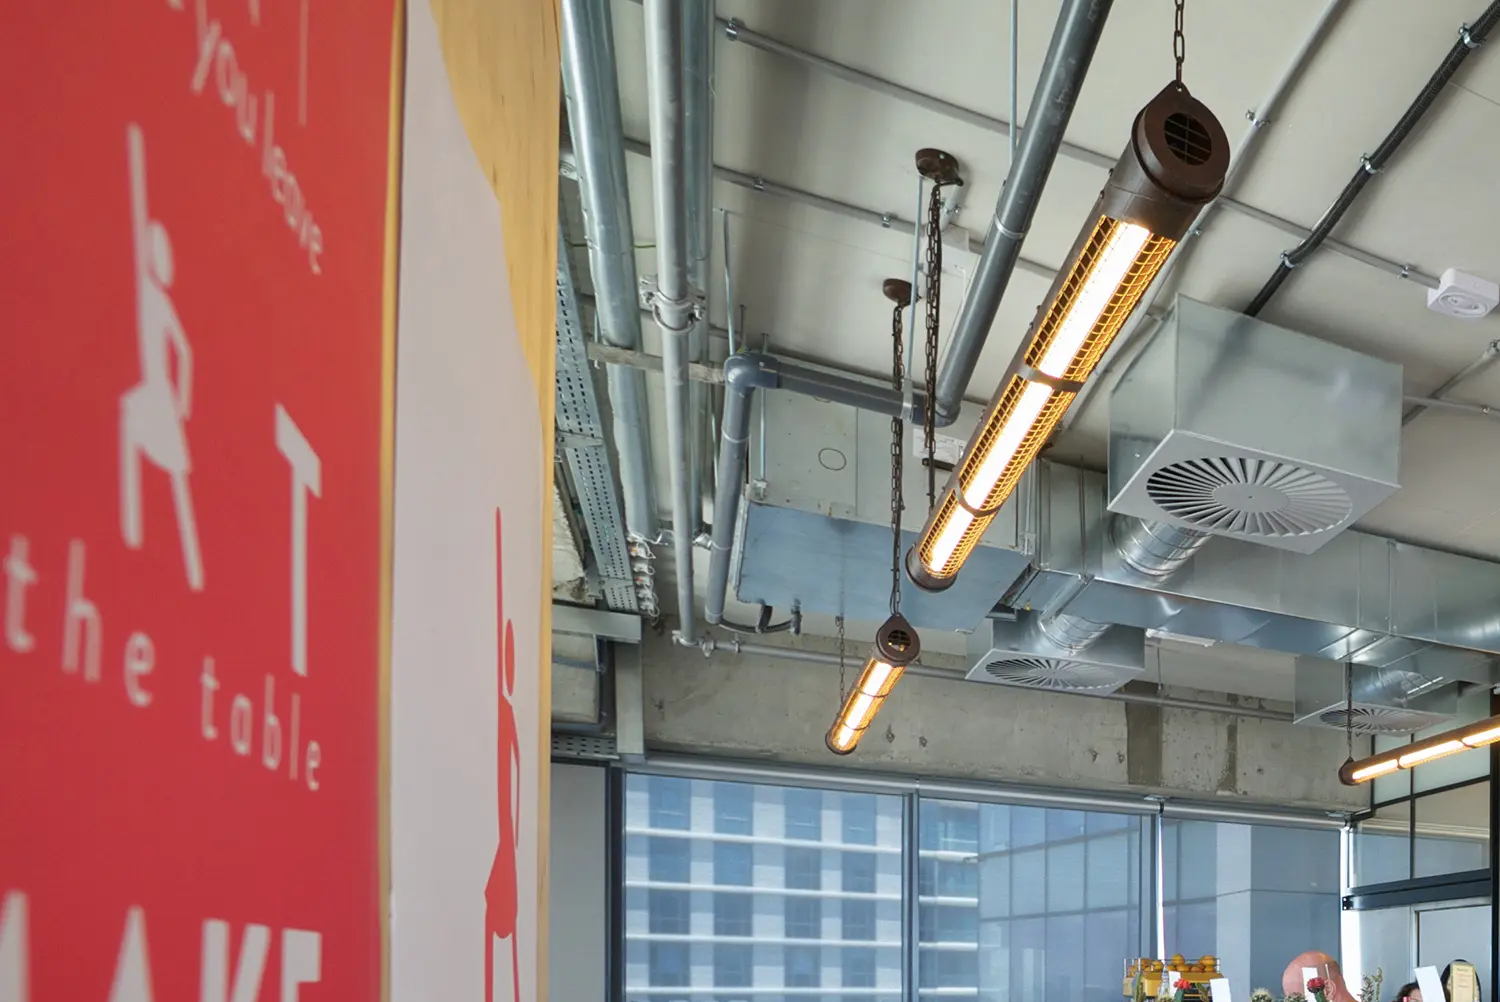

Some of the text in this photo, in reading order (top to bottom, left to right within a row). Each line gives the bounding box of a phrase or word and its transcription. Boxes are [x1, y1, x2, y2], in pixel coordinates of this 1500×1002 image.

[261, 89, 324, 276] leave
[2, 533, 322, 793] the table
